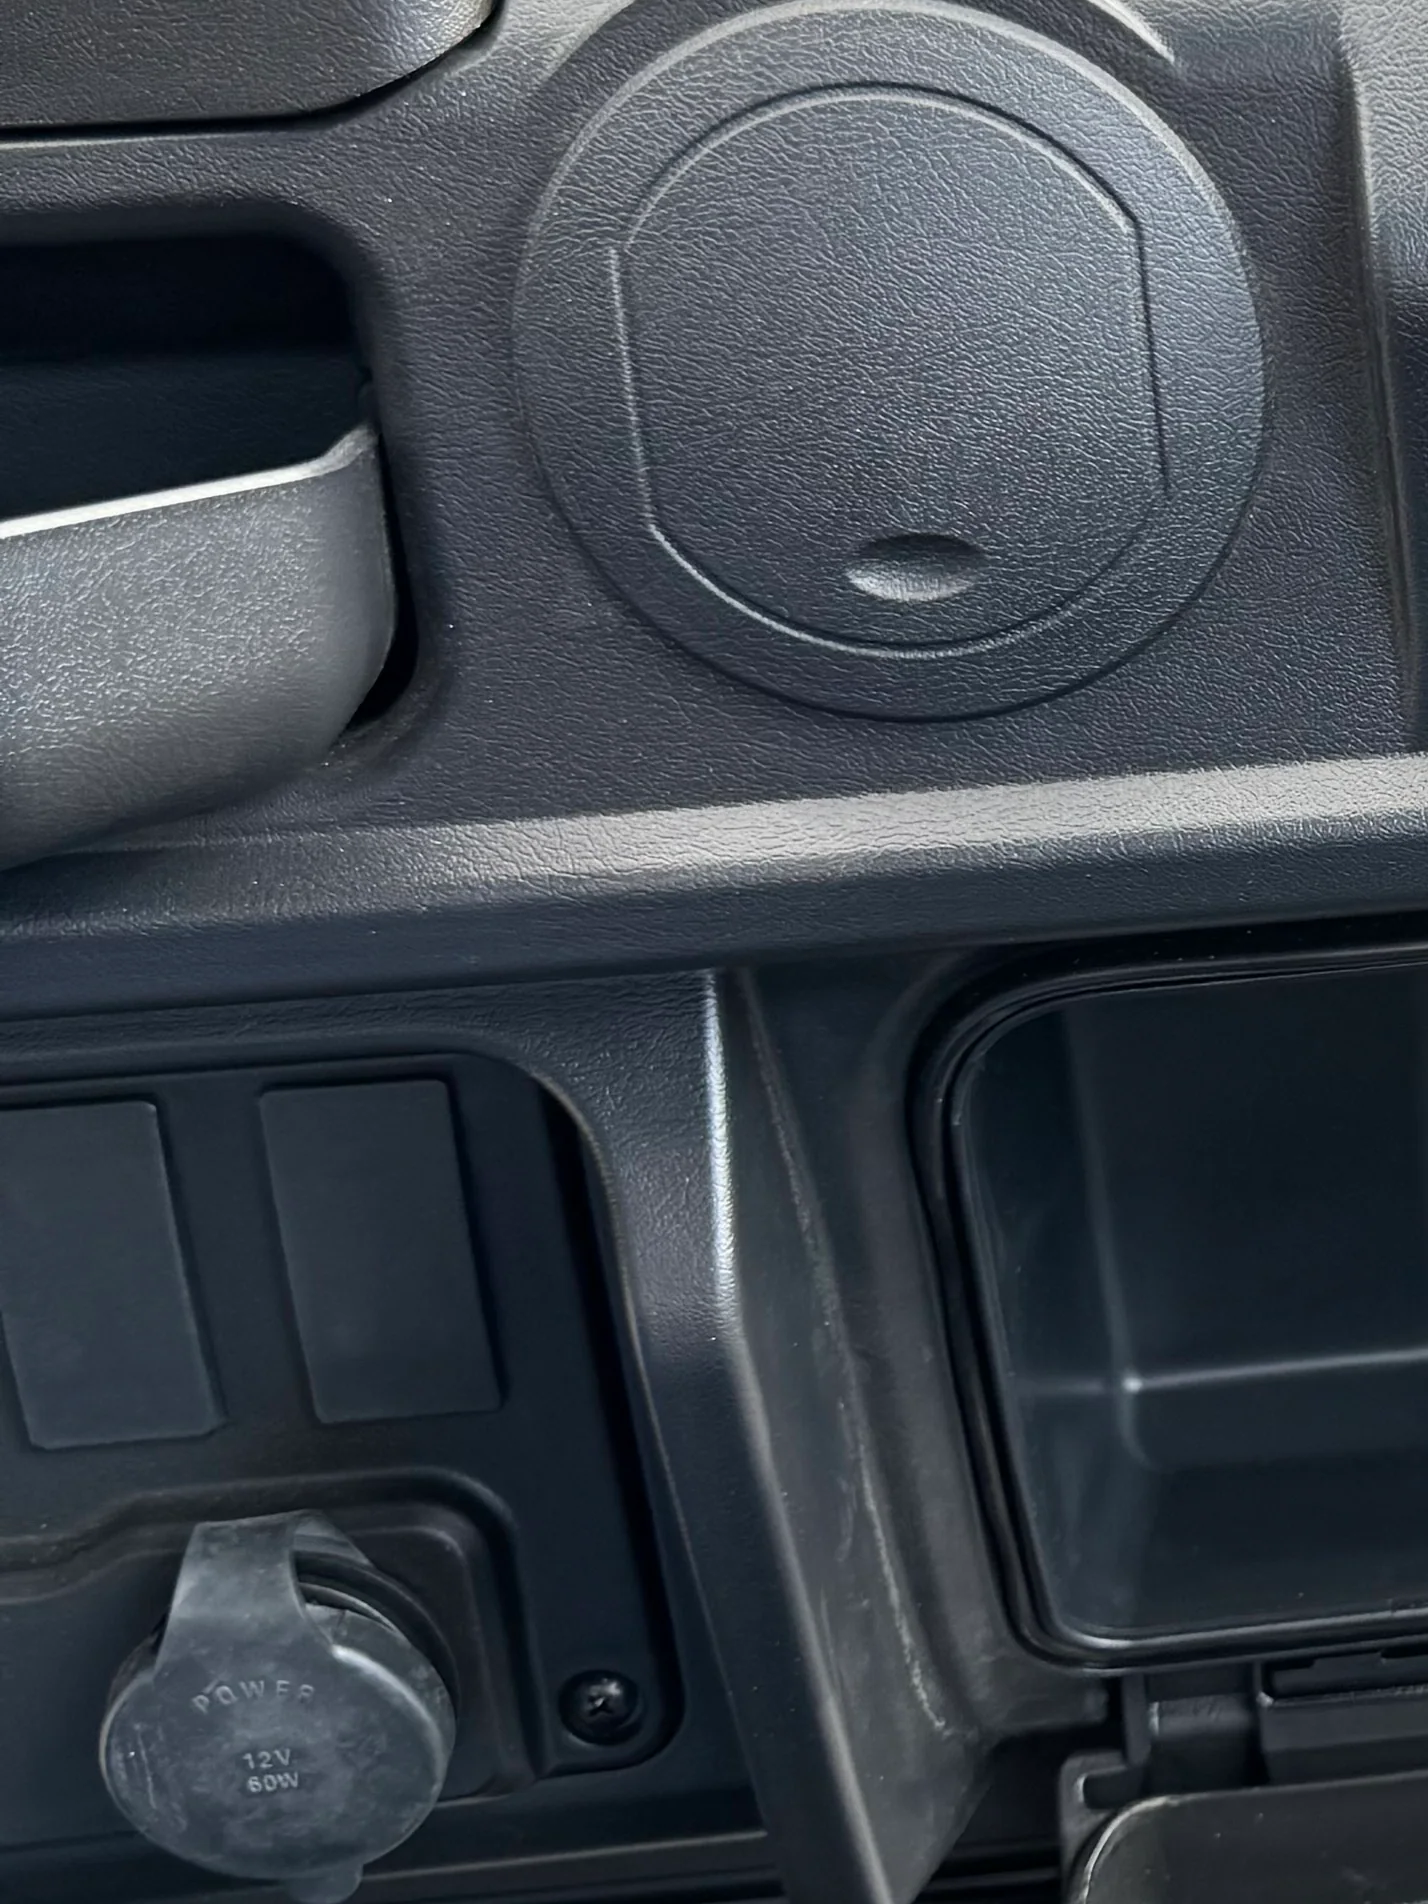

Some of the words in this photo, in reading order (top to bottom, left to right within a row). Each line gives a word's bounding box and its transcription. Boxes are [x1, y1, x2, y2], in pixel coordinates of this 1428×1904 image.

[191, 1680, 316, 1714] POWER
[242, 1748, 292, 1770] 12V
[247, 1772, 300, 1794] 60W
